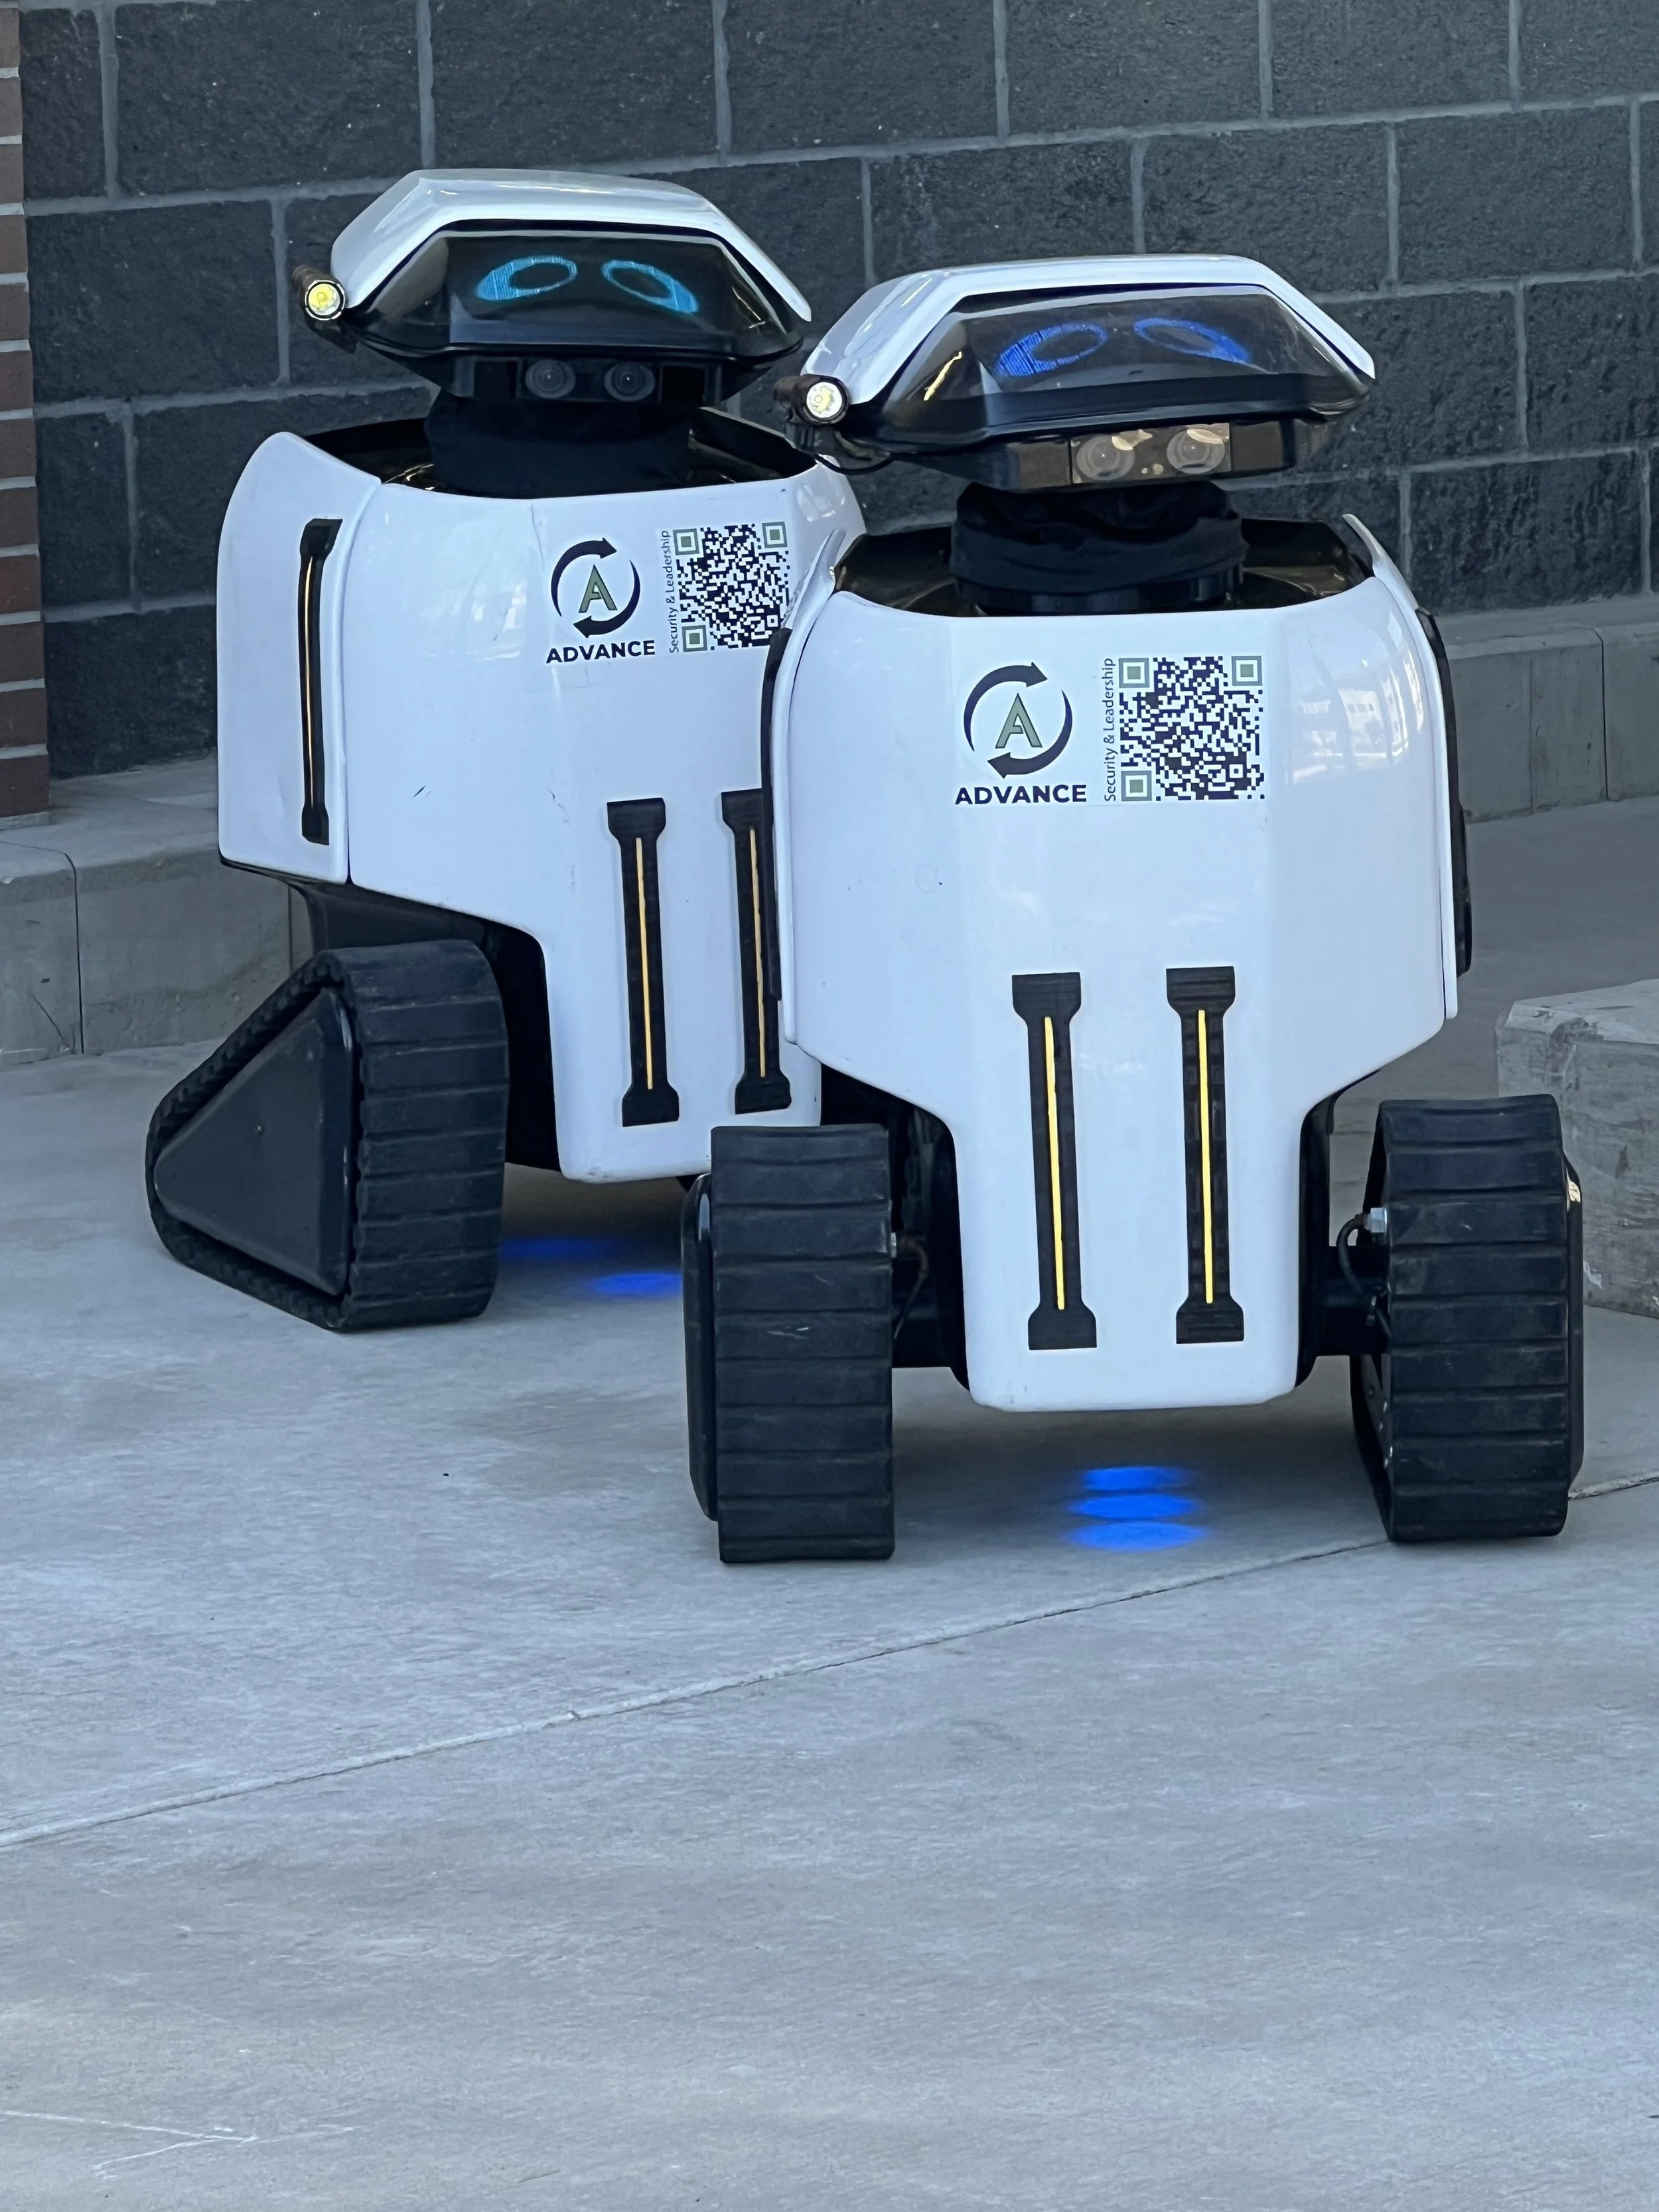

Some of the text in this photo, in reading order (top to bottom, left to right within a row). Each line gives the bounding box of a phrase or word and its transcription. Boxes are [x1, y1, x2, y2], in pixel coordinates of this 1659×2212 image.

[660, 530, 674, 593] Leadership
[578, 564, 618, 614] A
[545, 640, 656, 664] ADVANCE
[668, 607, 679, 653] Security
[995, 693, 1043, 749] A
[1101, 658, 1118, 802] Security & Leadership
[954, 784, 1087, 805] ADVANCE
